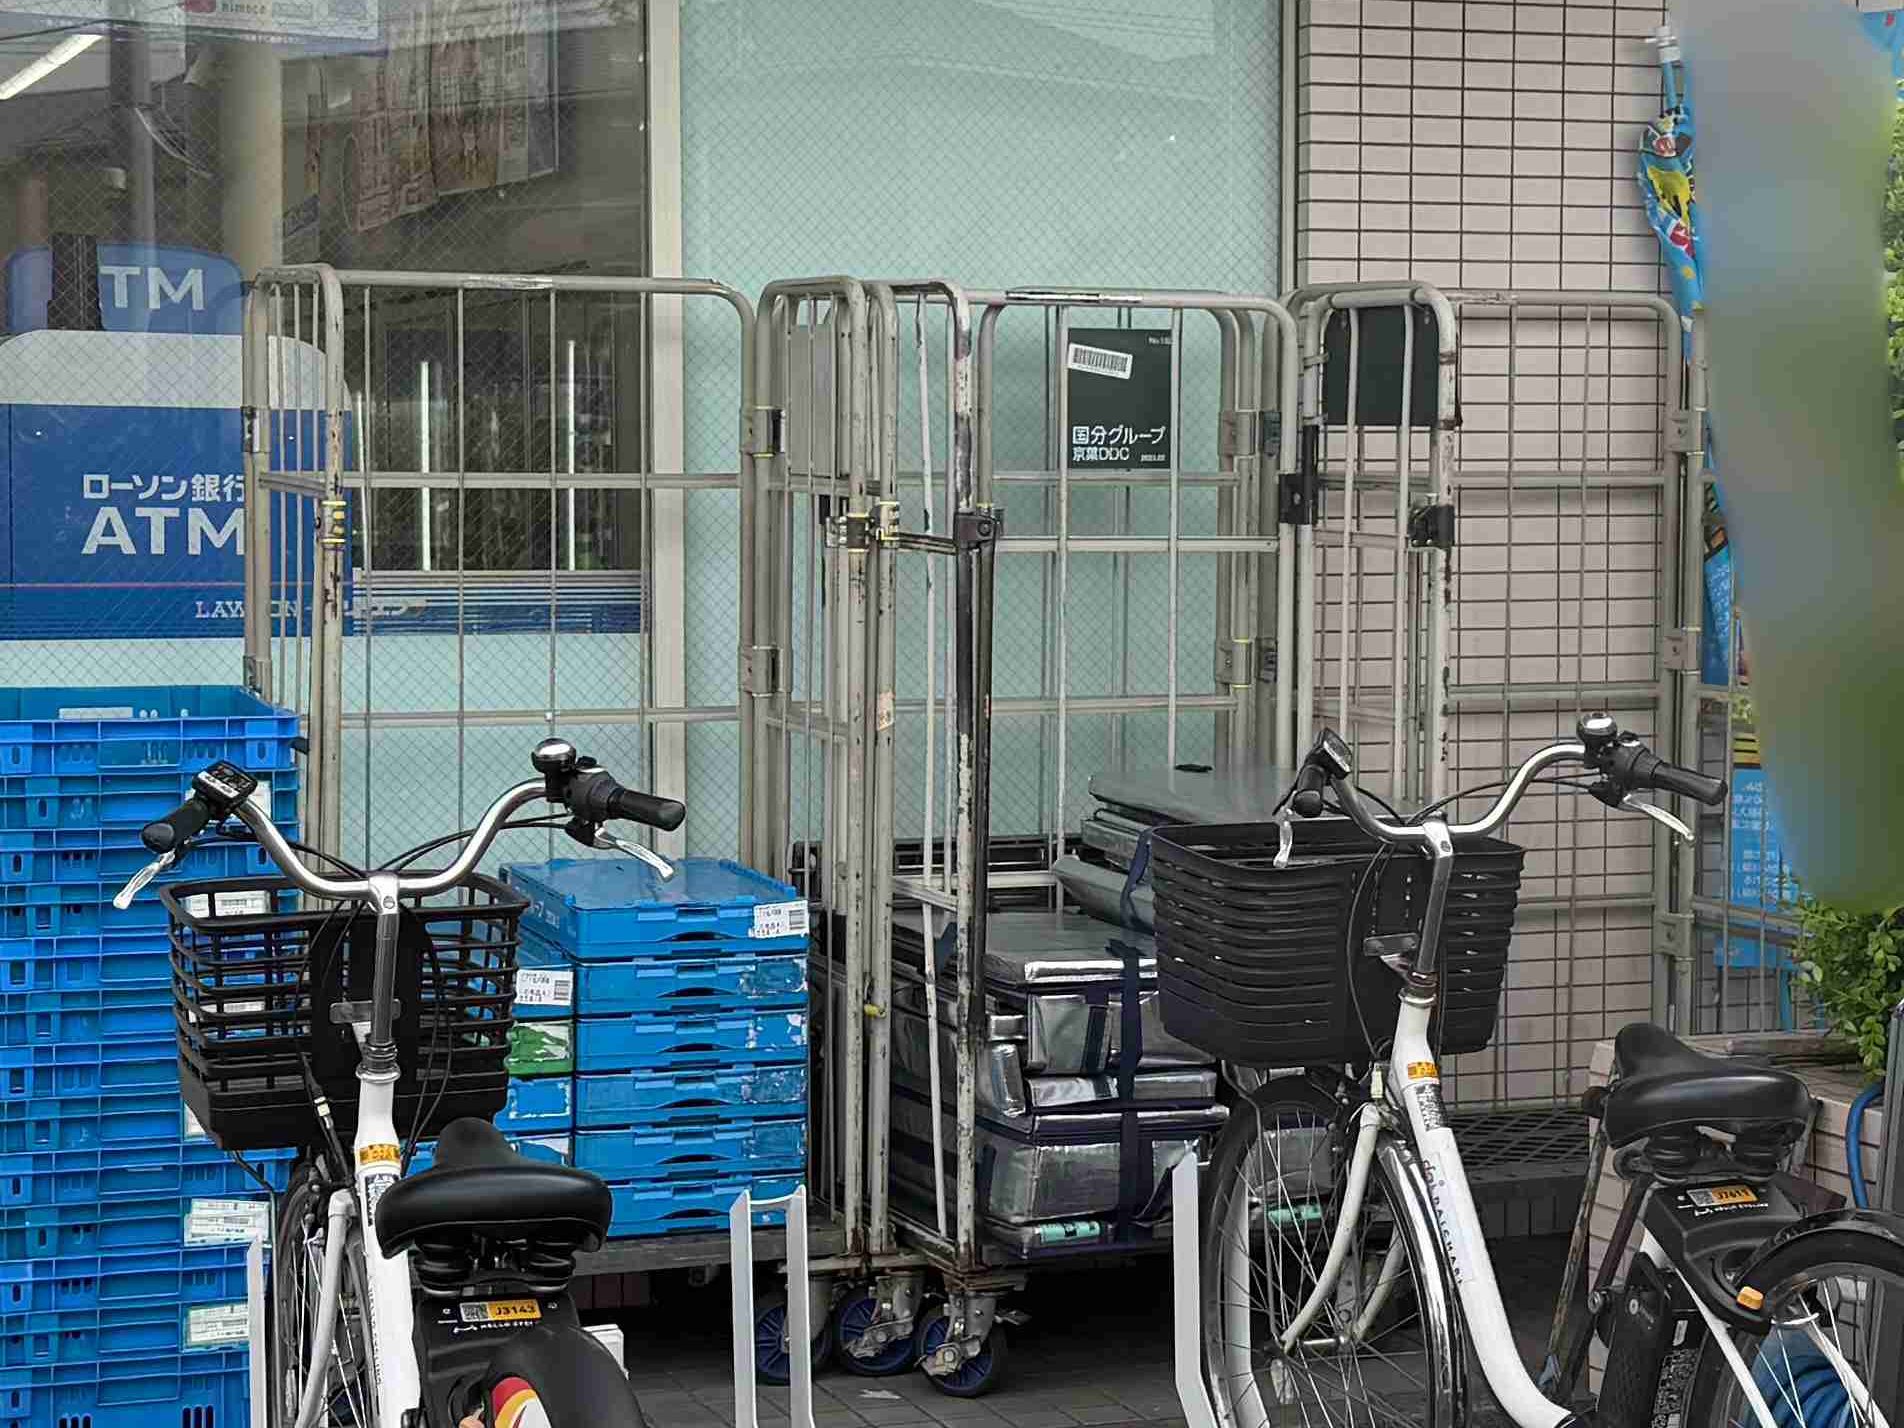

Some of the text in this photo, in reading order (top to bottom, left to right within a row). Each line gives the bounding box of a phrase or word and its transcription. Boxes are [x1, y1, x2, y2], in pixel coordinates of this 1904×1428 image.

[98, 266, 204, 311] TM
[1072, 424, 1166, 445] 国分グループ
[83, 472, 246, 504] ローソン銀行
[81, 507, 246, 556] ATM
